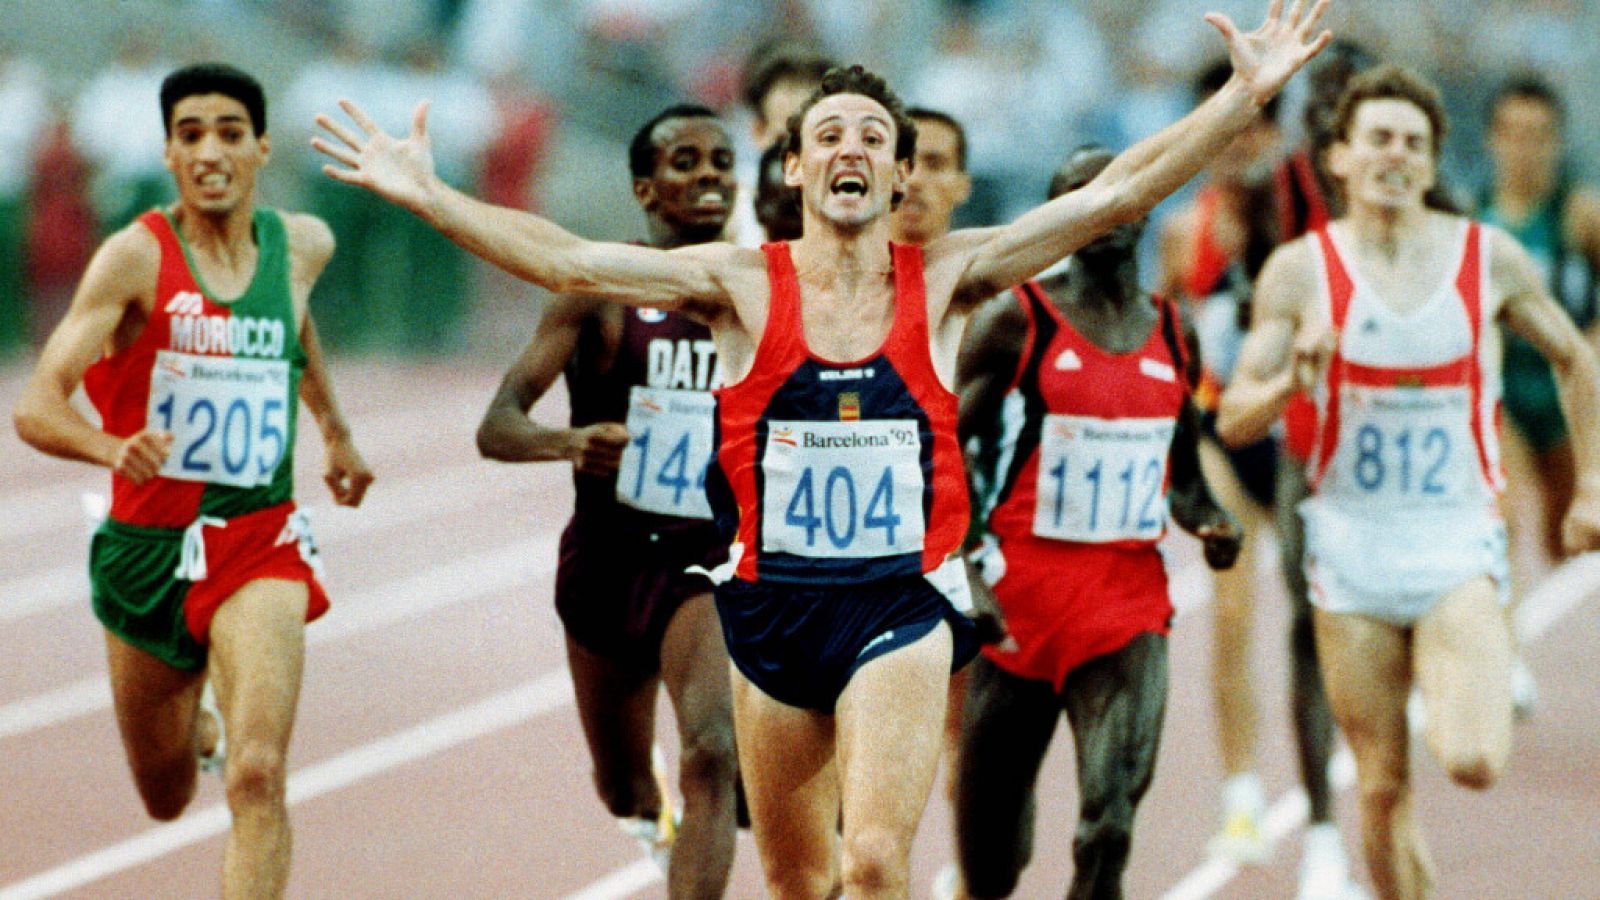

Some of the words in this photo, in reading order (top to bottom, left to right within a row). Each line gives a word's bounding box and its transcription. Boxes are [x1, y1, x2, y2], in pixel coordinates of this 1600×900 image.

[170, 315, 284, 356] MOROCCO
[157, 395, 282, 475] 1205
[803, 432, 888, 448] Barcelona
[890, 428, 914, 446] '92
[1354, 423, 1451, 493] 812
[785, 466, 901, 549] 404
[1051, 456, 1159, 530] 1112
